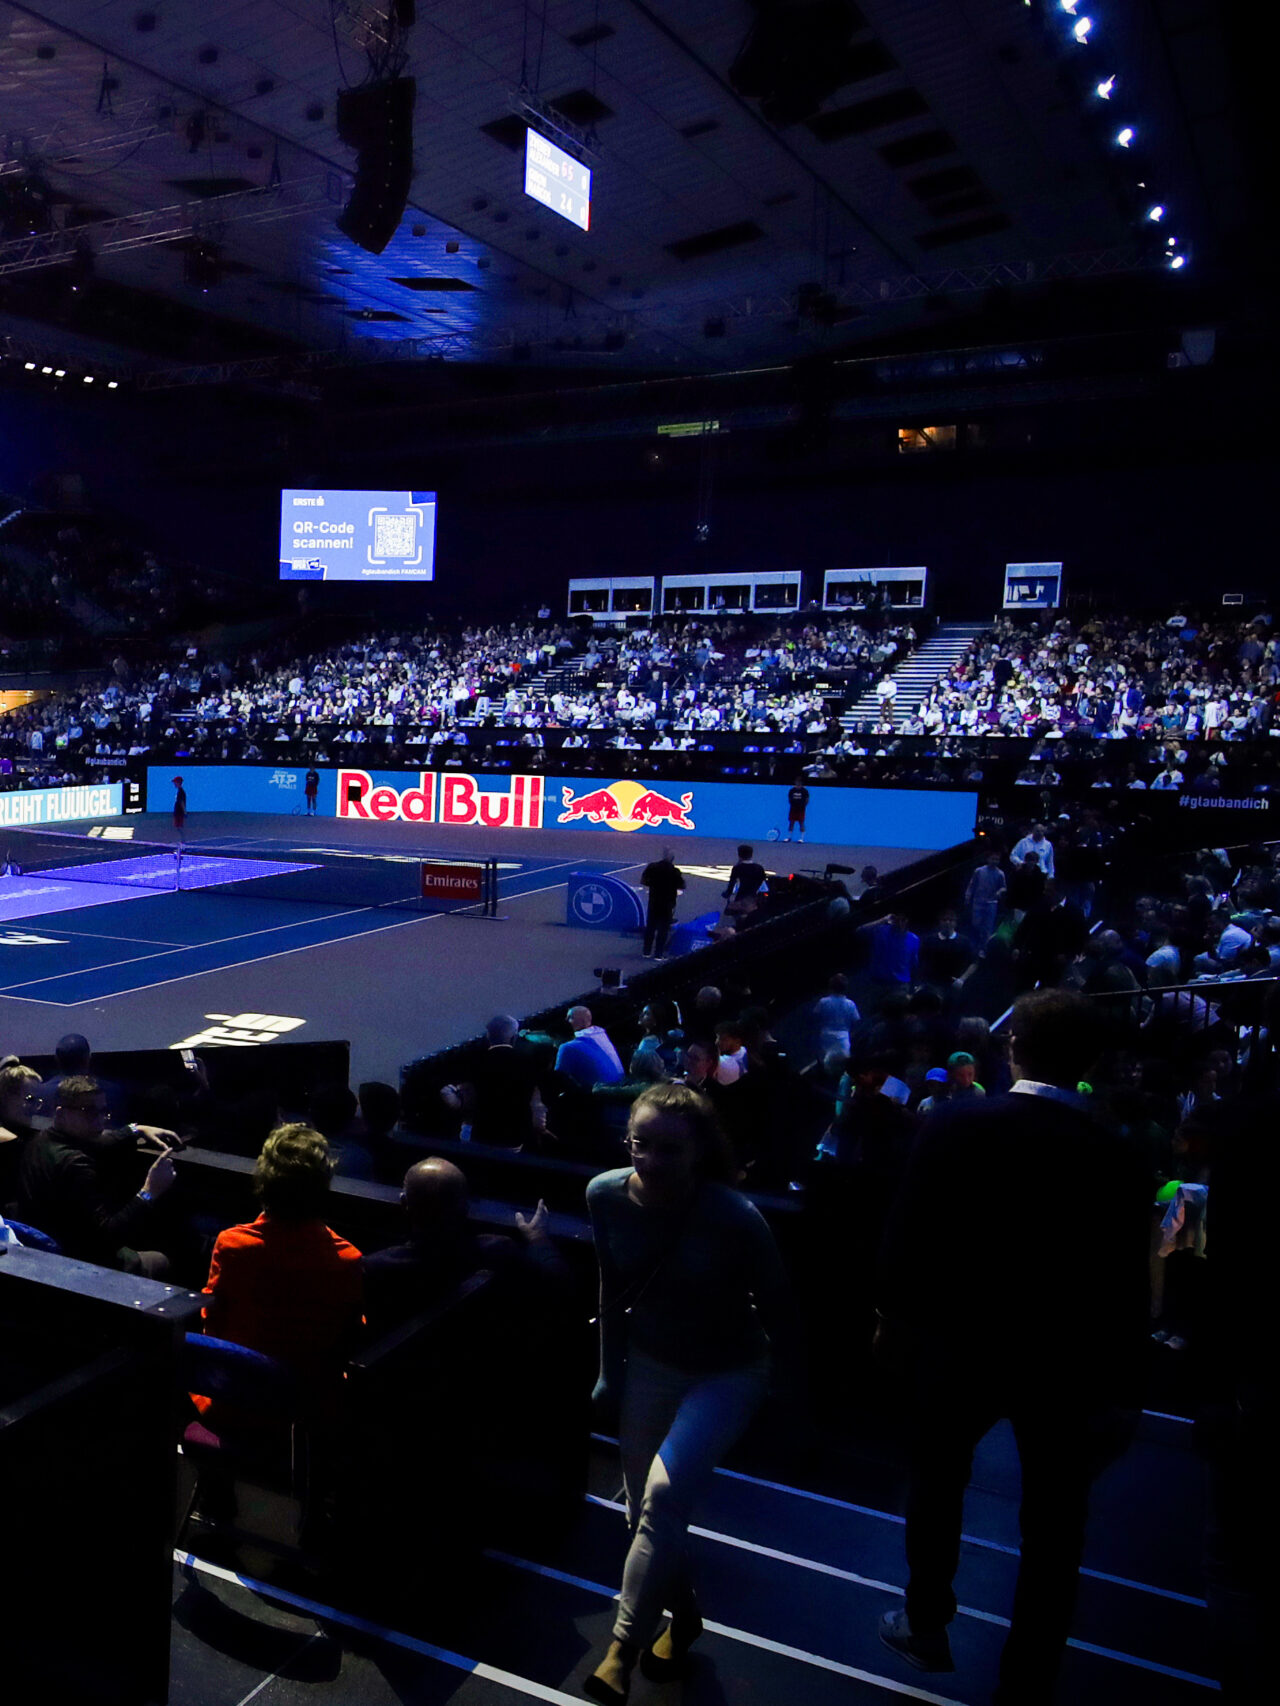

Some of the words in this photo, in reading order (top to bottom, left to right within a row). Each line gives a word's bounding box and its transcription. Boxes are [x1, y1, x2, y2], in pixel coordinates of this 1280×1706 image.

[293, 521, 355, 534] QR-Code
[293, 537, 353, 548] scannen!
[85, 757, 127, 766] #glaubandich
[268, 774, 297, 785] ATP
[47, 786, 117, 820] FLÜÜÜGEL.
[338, 771, 435, 822] Red
[441, 775, 542, 827] Bull
[1179, 795, 1269, 810] #glaubandich
[425, 874, 478, 889] Emirates
